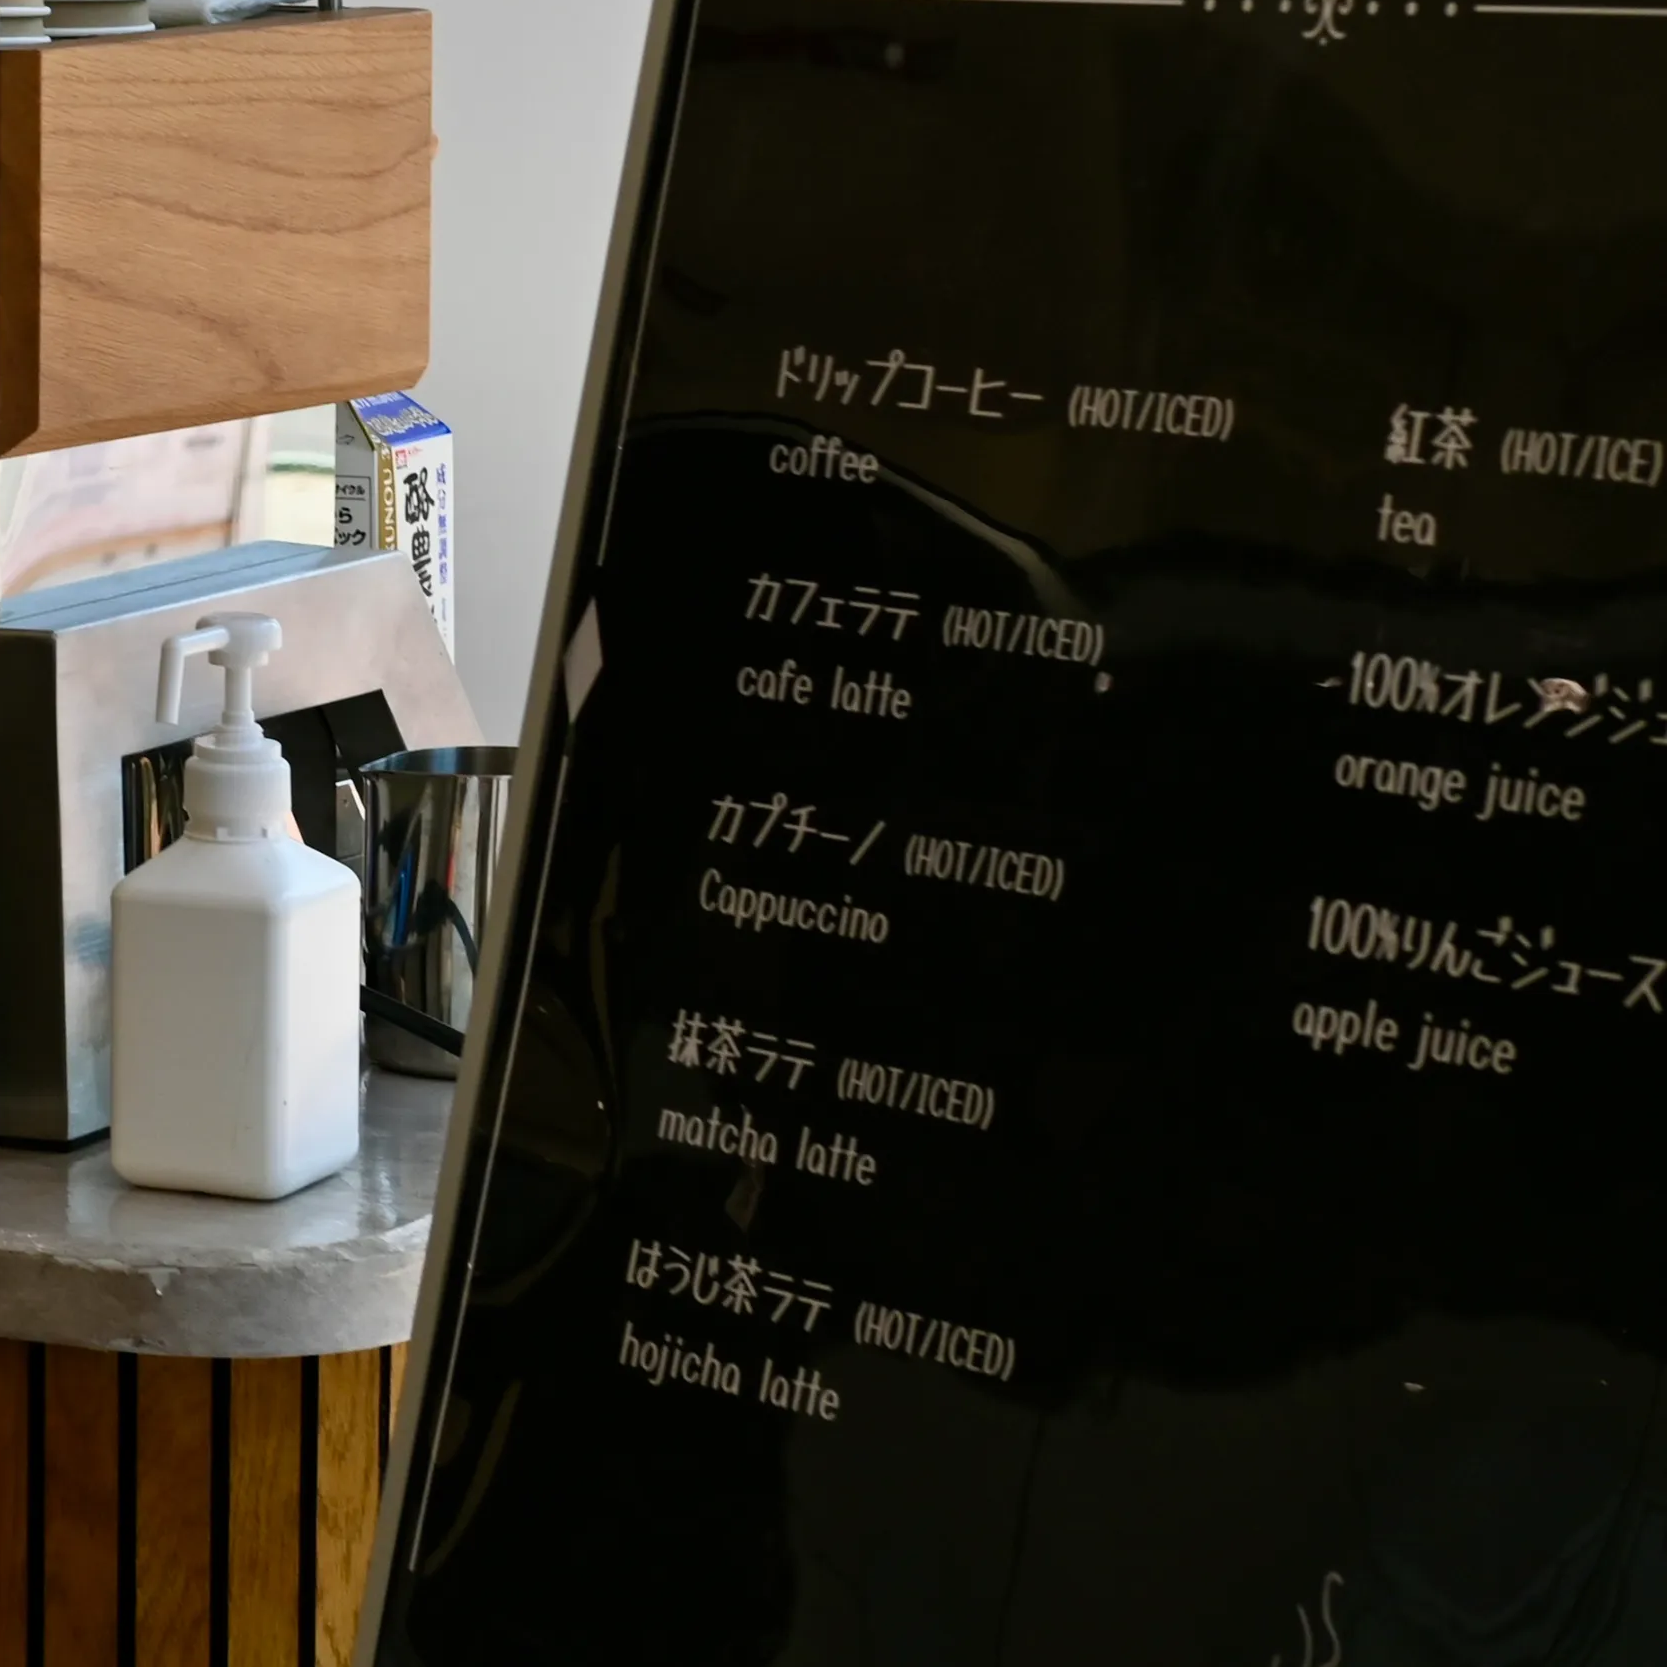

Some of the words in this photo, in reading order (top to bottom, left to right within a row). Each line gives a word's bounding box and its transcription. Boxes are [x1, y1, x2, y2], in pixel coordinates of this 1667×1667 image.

[776, 345, 1044, 418] ドリップコーヒー
[1068, 385, 1235, 442] (HOT/ICED)
[769, 434, 881, 484] coffee
[1384, 403, 1477, 470] 紅茶
[1500, 428, 1664, 487] (HOT/ICE)
[1378, 493, 1437, 546] tea
[745, 572, 920, 641] カフェラテ
[942, 605, 1105, 667] (HOT/ICED)
[737, 658, 813, 705] cafe
[830, 665, 912, 720] latte
[1350, 651, 1667, 745] 100%オレンジジ
[1335, 754, 1467, 812] orange
[1475, 767, 1586, 821] juice
[707, 791, 886, 866] カプチーノ
[904, 834, 1065, 902] (HOT/ICED)
[699, 867, 889, 944] Cappuccino
[667, 1008, 816, 1090] 抹茶ラテ
[837, 1057, 995, 1131] (HOT/ICED)
[1292, 999, 1399, 1055] apple
[1406, 1018, 1517, 1075] juice
[657, 1106, 778, 1165] matcha
[795, 1125, 877, 1186] latte
[619, 1320, 741, 1396] hojicha
[759, 1357, 840, 1421] latte
[854, 1301, 1015, 1382] (HOT/ICED)
